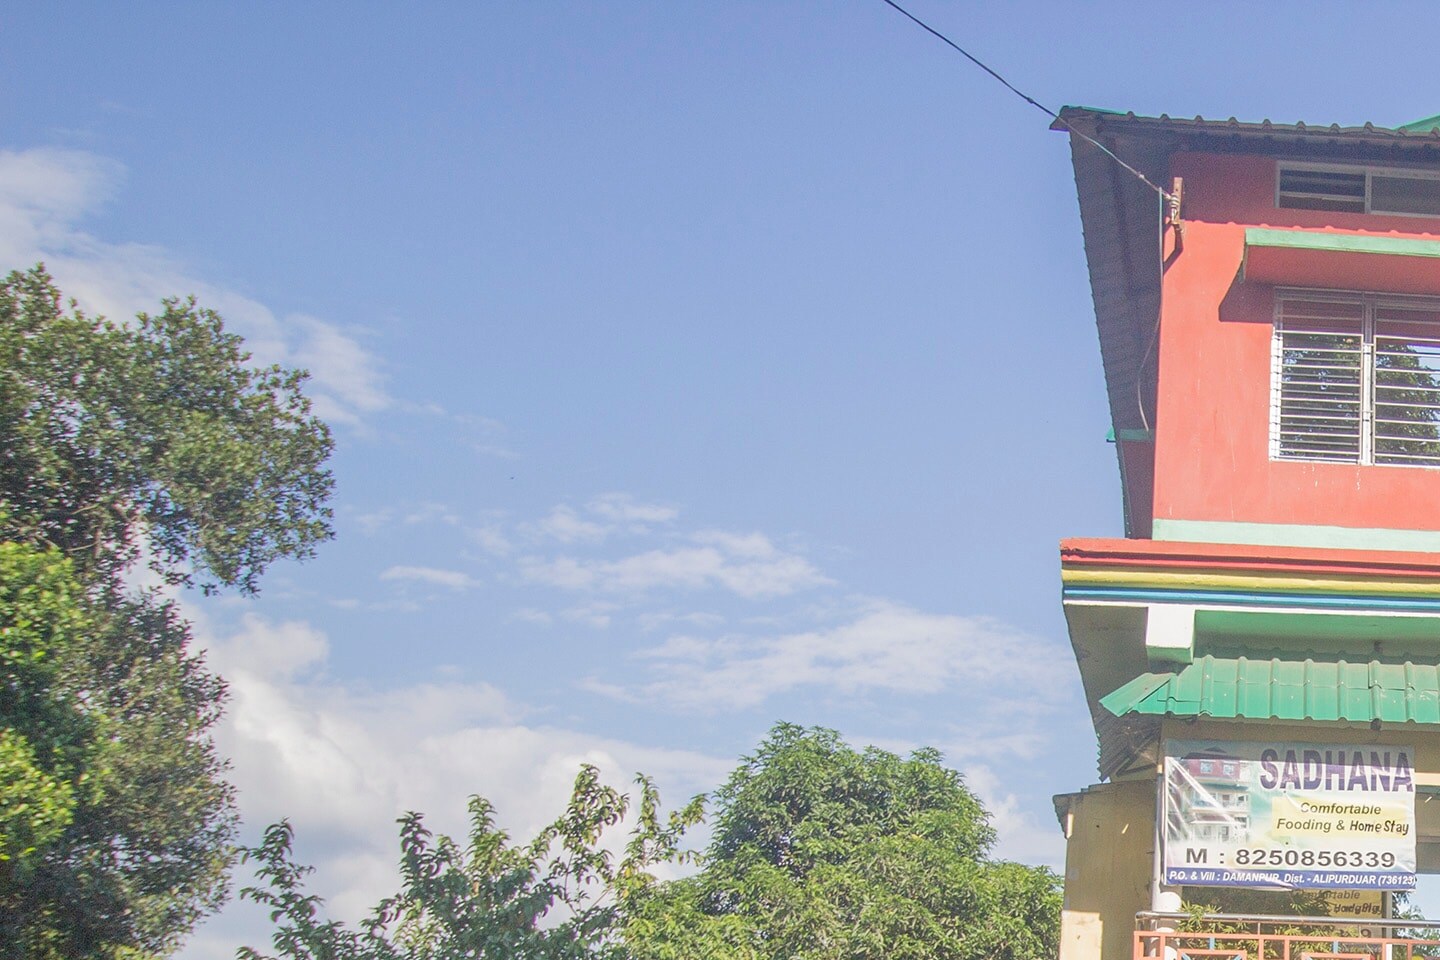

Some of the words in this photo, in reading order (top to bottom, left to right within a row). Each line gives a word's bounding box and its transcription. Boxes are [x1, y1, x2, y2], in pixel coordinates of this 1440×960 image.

[1259, 748, 1414, 793] SADHANA
[1300, 802, 1382, 815] Comfortable
[1276, 818, 1332, 833] Fooding
[1336, 819, 1346, 831] &
[1186, 847, 1208, 864] M
[1235, 849, 1396, 868] 8250856339
[1169, 870, 1188, 880] P.O.
[1190, 871, 1198, 880] &
[1200, 871, 1215, 881] Vill
[1284, 873, 1305, 883] Dist.
[1312, 874, 1376, 884] ALIPURDUAR
[1378, 875, 1416, 886] (736123)
